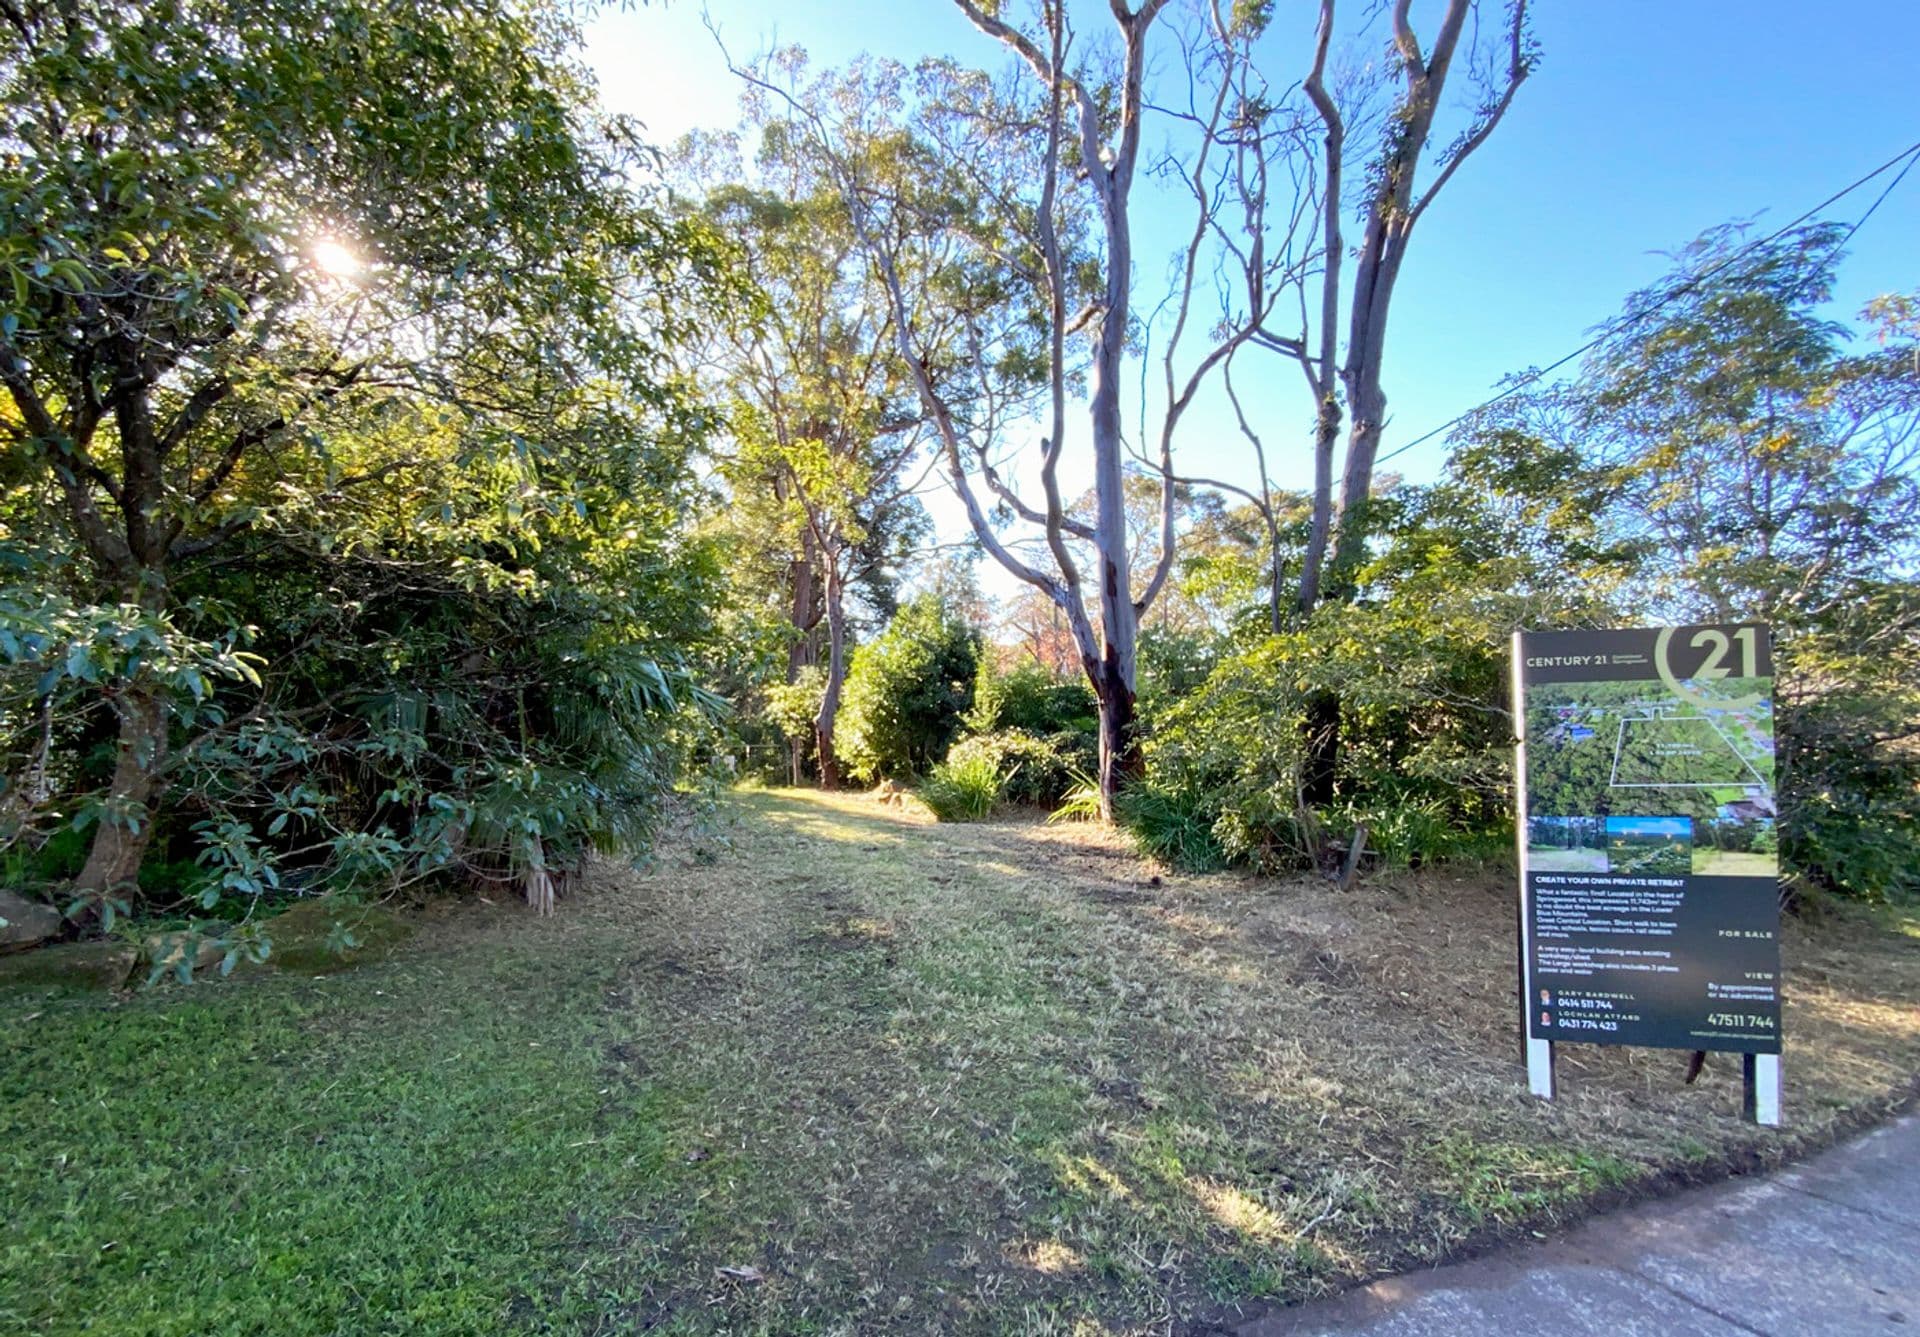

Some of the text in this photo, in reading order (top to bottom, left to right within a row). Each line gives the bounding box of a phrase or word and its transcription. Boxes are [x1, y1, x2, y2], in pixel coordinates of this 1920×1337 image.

[1690, 627, 1757, 679] 21
[1526, 656, 1591, 668] CENTURY
[1594, 655, 1607, 665] 21
[1535, 876, 1567, 884] CREATE
[1590, 877, 1612, 885] OWN
[1612, 878, 1646, 886] PRIVATE
[1647, 878, 1685, 887] RETREAT
[1744, 930, 1773, 939] SALE
[1744, 972, 1774, 980] VIEW
[1708, 982, 1720, 991] By
[1585, 991, 1635, 1000] BARDWELL
[1558, 998, 1613, 1010] 0414 511 744
[1558, 1010, 1641, 1021] LOCHLAN ATTARD
[1707, 1013, 1774, 1029] 47511 744
[1559, 1019, 1617, 1031] 0431 774 423
